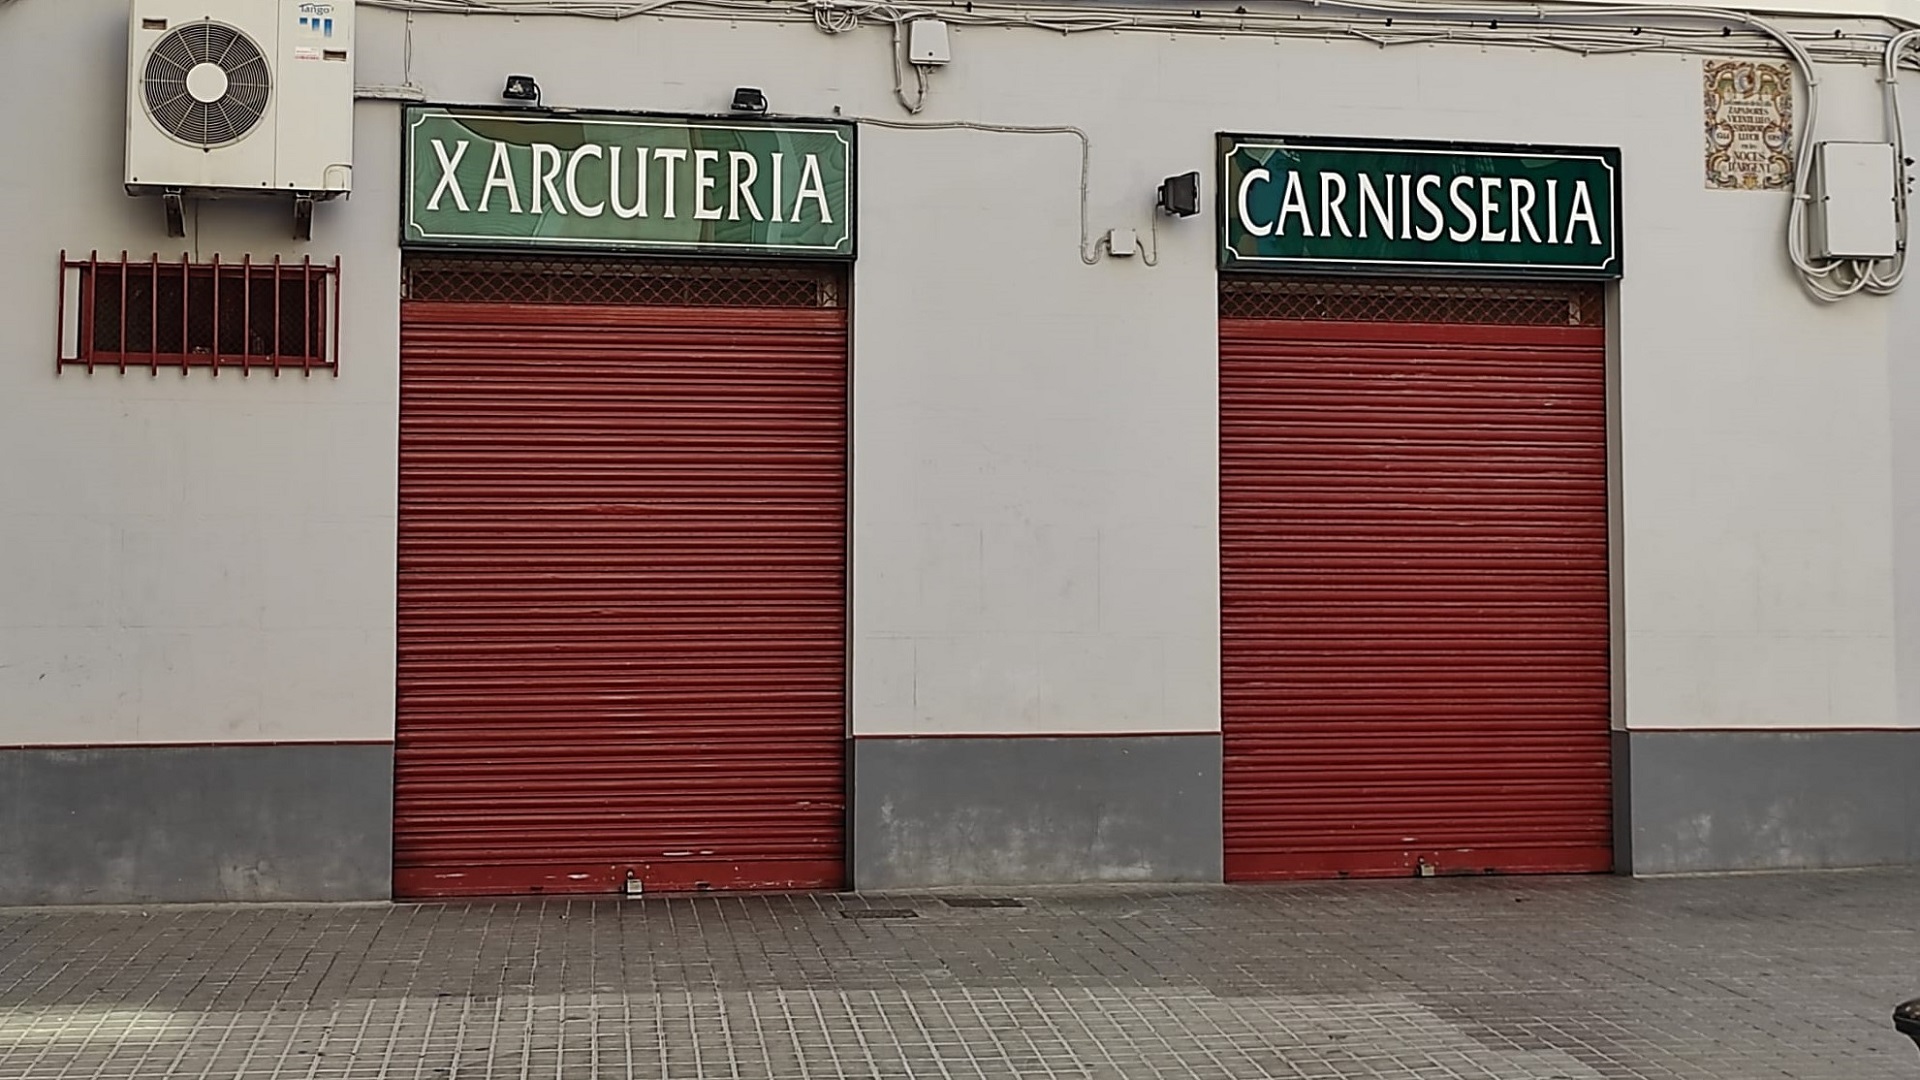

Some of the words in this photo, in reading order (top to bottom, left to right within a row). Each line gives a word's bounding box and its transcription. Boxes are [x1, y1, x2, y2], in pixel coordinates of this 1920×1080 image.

[299, 3, 331, 16] Tango
[1733, 151, 1766, 161] NOCES
[426, 138, 834, 224] XARCUTERIA
[1238, 168, 1603, 246] CARNISSERIA
